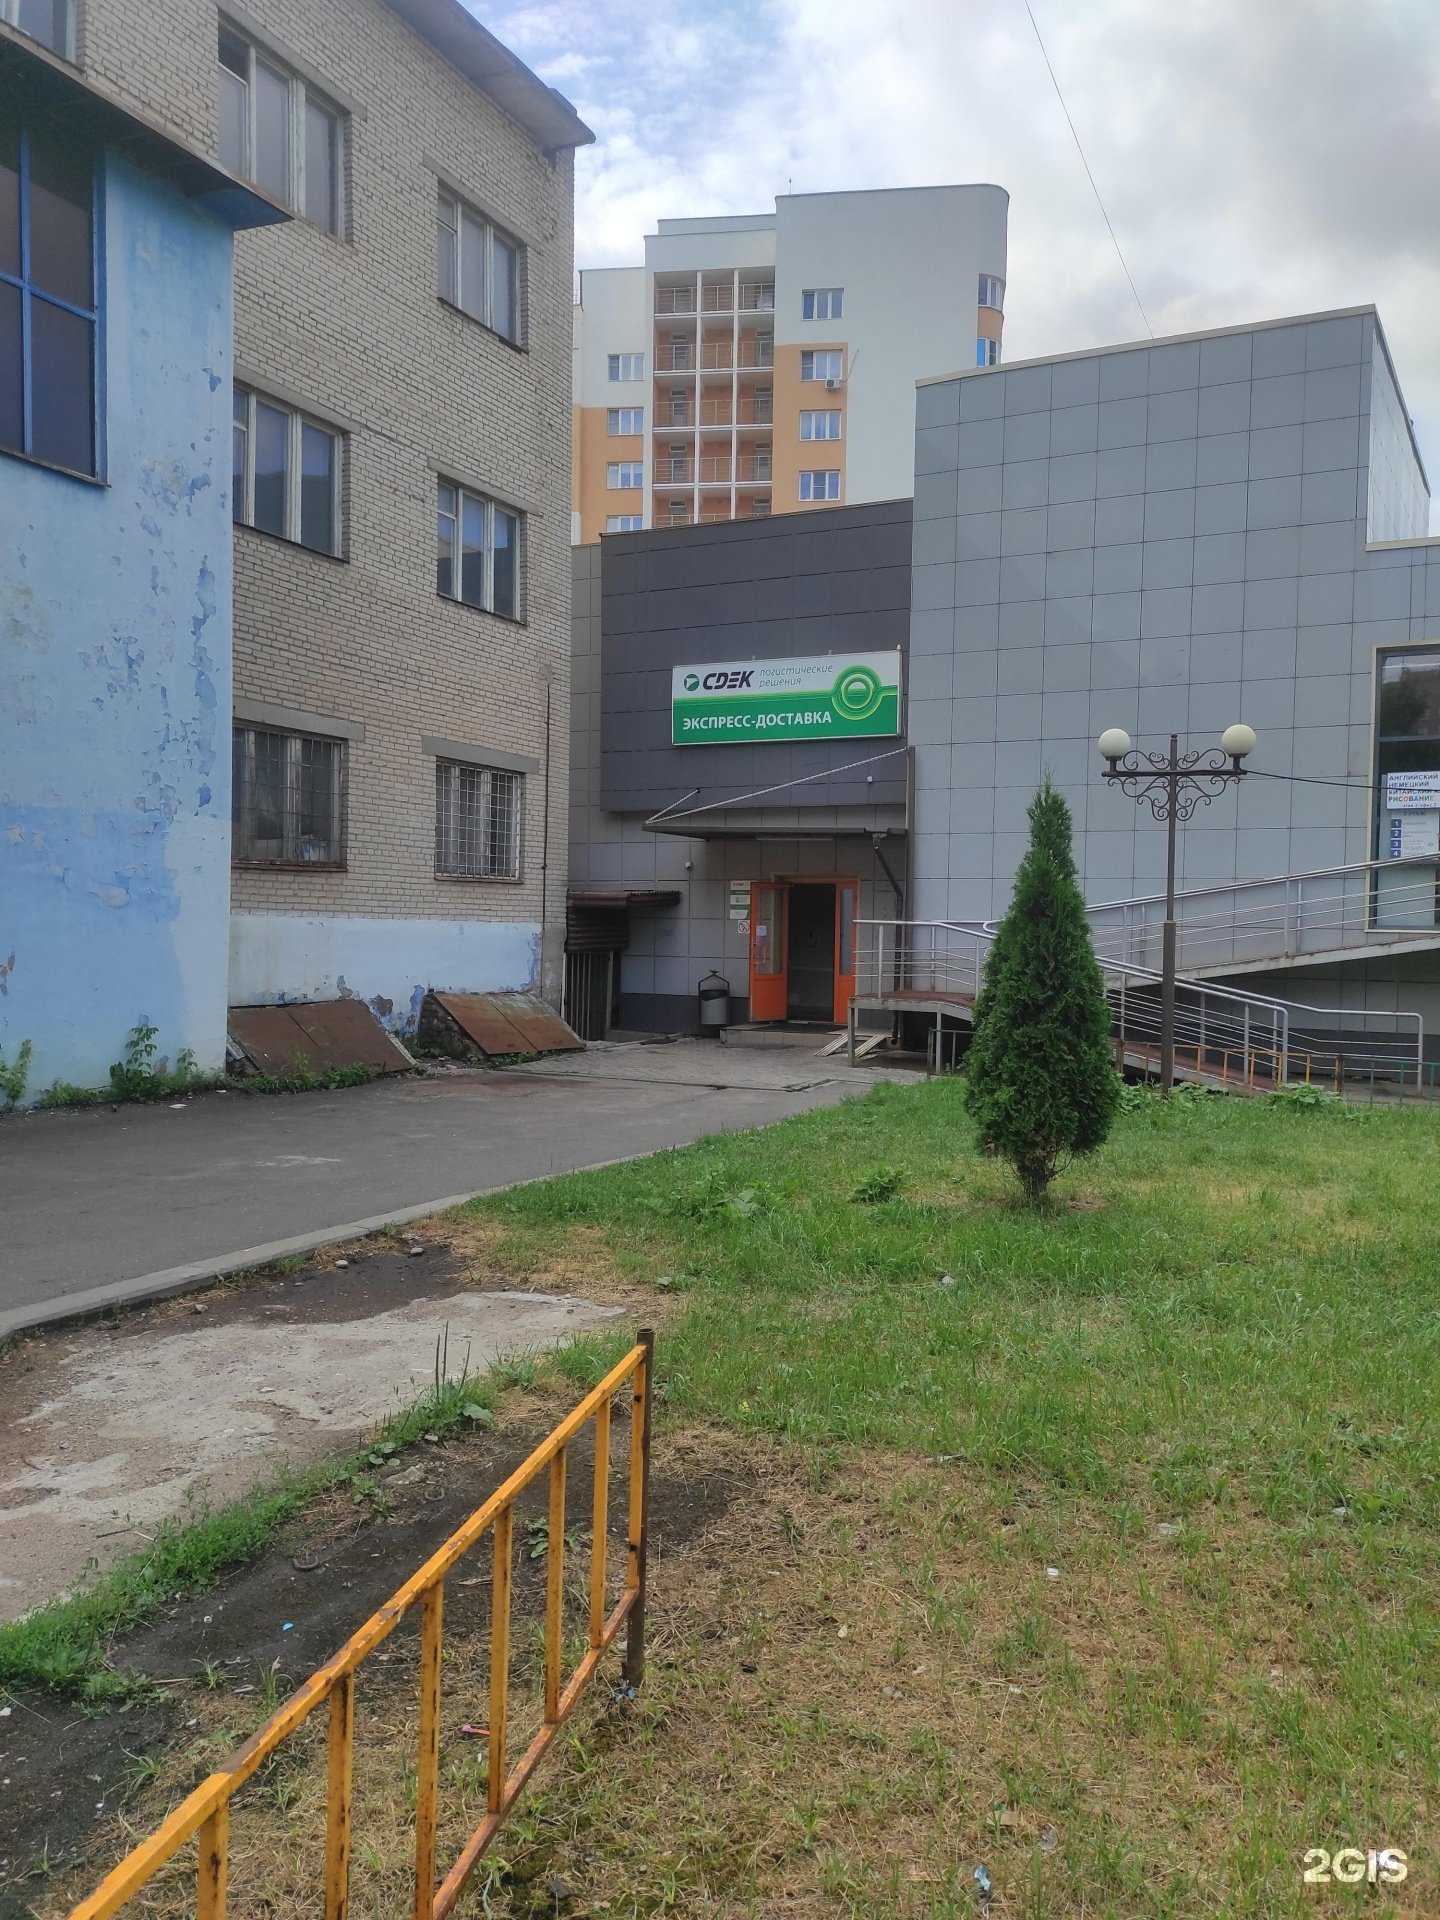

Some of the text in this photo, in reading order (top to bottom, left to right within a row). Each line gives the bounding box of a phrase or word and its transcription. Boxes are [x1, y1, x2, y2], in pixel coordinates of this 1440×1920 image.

[760, 663, 833, 677] логистические
[702, 671, 755, 690] CDEK
[759, 677, 802, 688] решения
[683, 711, 832, 730] ЭКСПРЕСС-ДОСТАВКА
